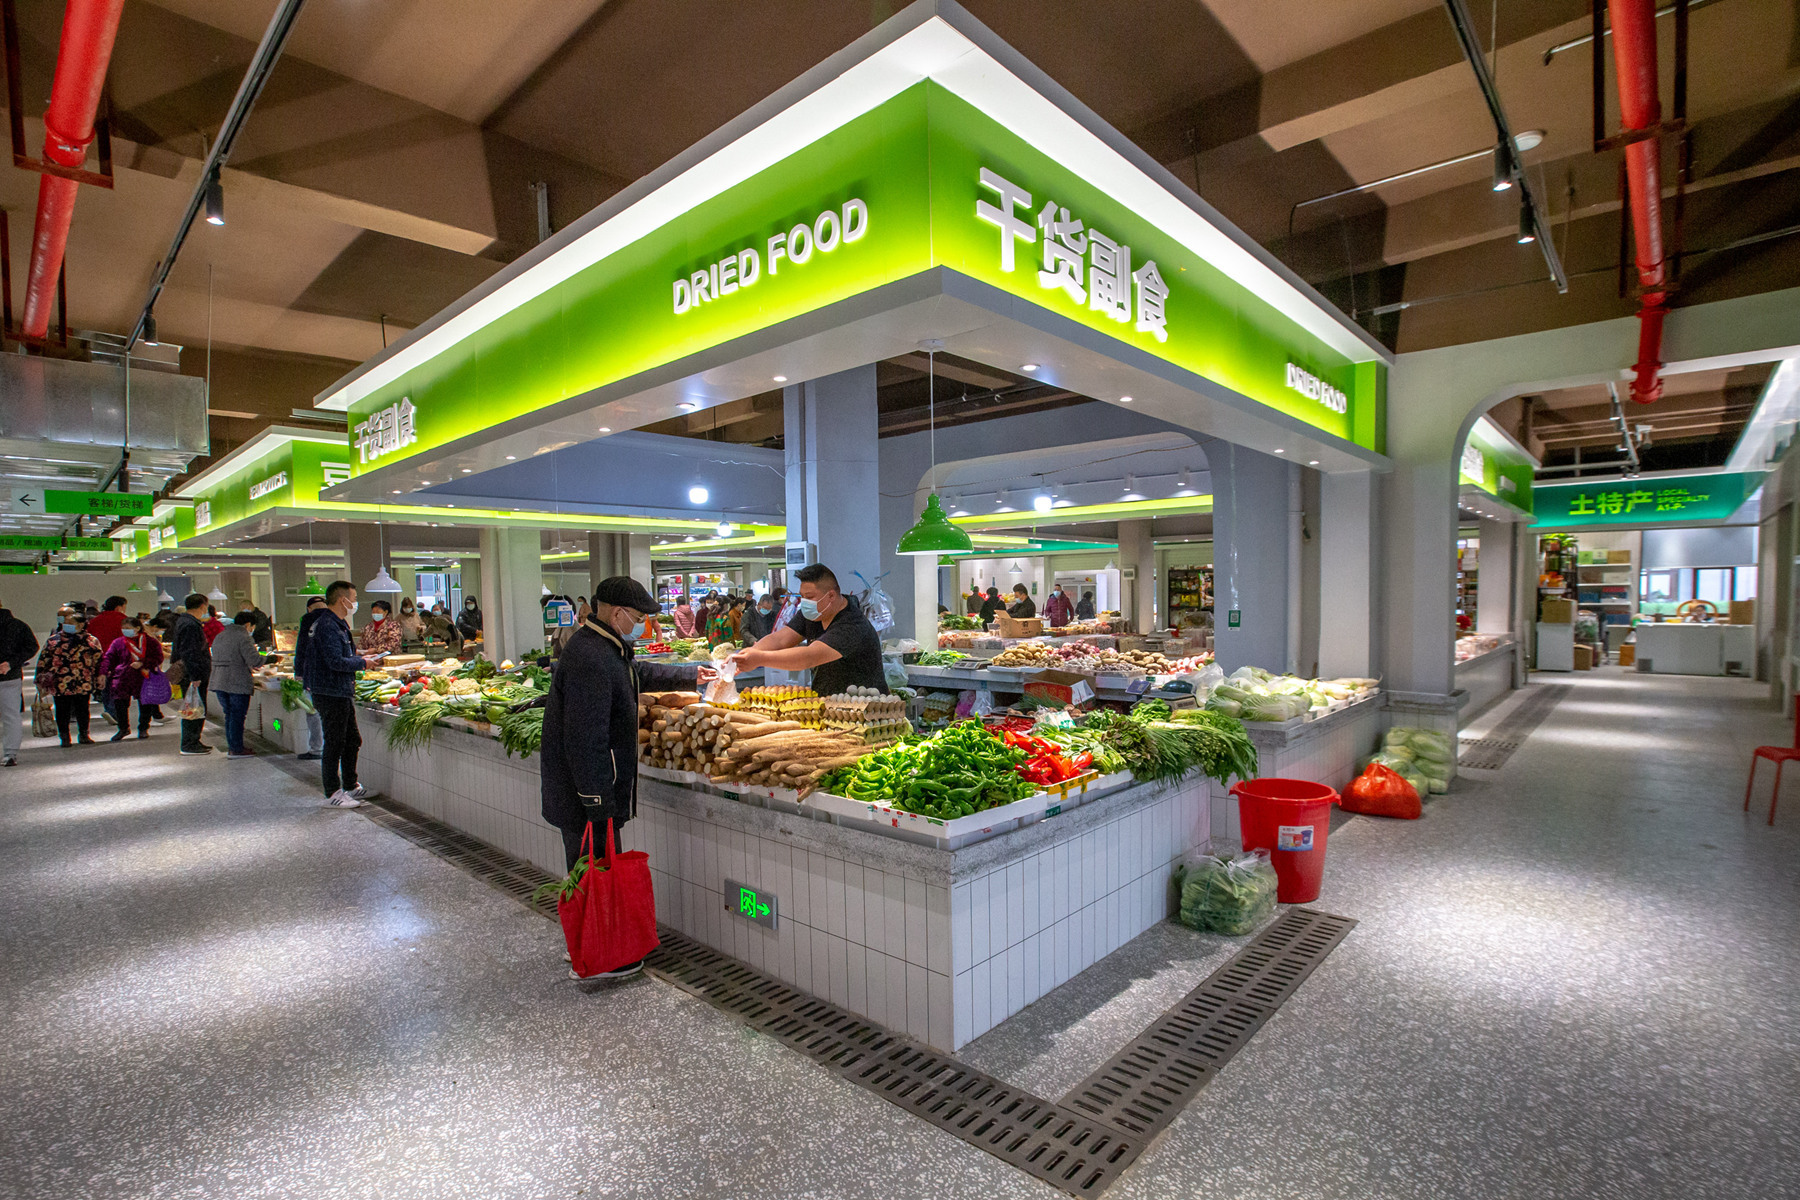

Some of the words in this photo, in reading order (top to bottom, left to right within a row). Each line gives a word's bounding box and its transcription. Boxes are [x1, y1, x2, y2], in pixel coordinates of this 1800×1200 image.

[672, 247, 759, 315] DRIED
[767, 198, 868, 275] FOOD
[976, 167, 1169, 342] 干货副食
[1286, 362, 1320, 400] DRIED
[1320, 381, 1347, 414] FOOD
[354, 396, 417, 464] 干货副食
[1568, 490, 1654, 515] 土特产
[1656, 488, 1691, 496] LOCAL
